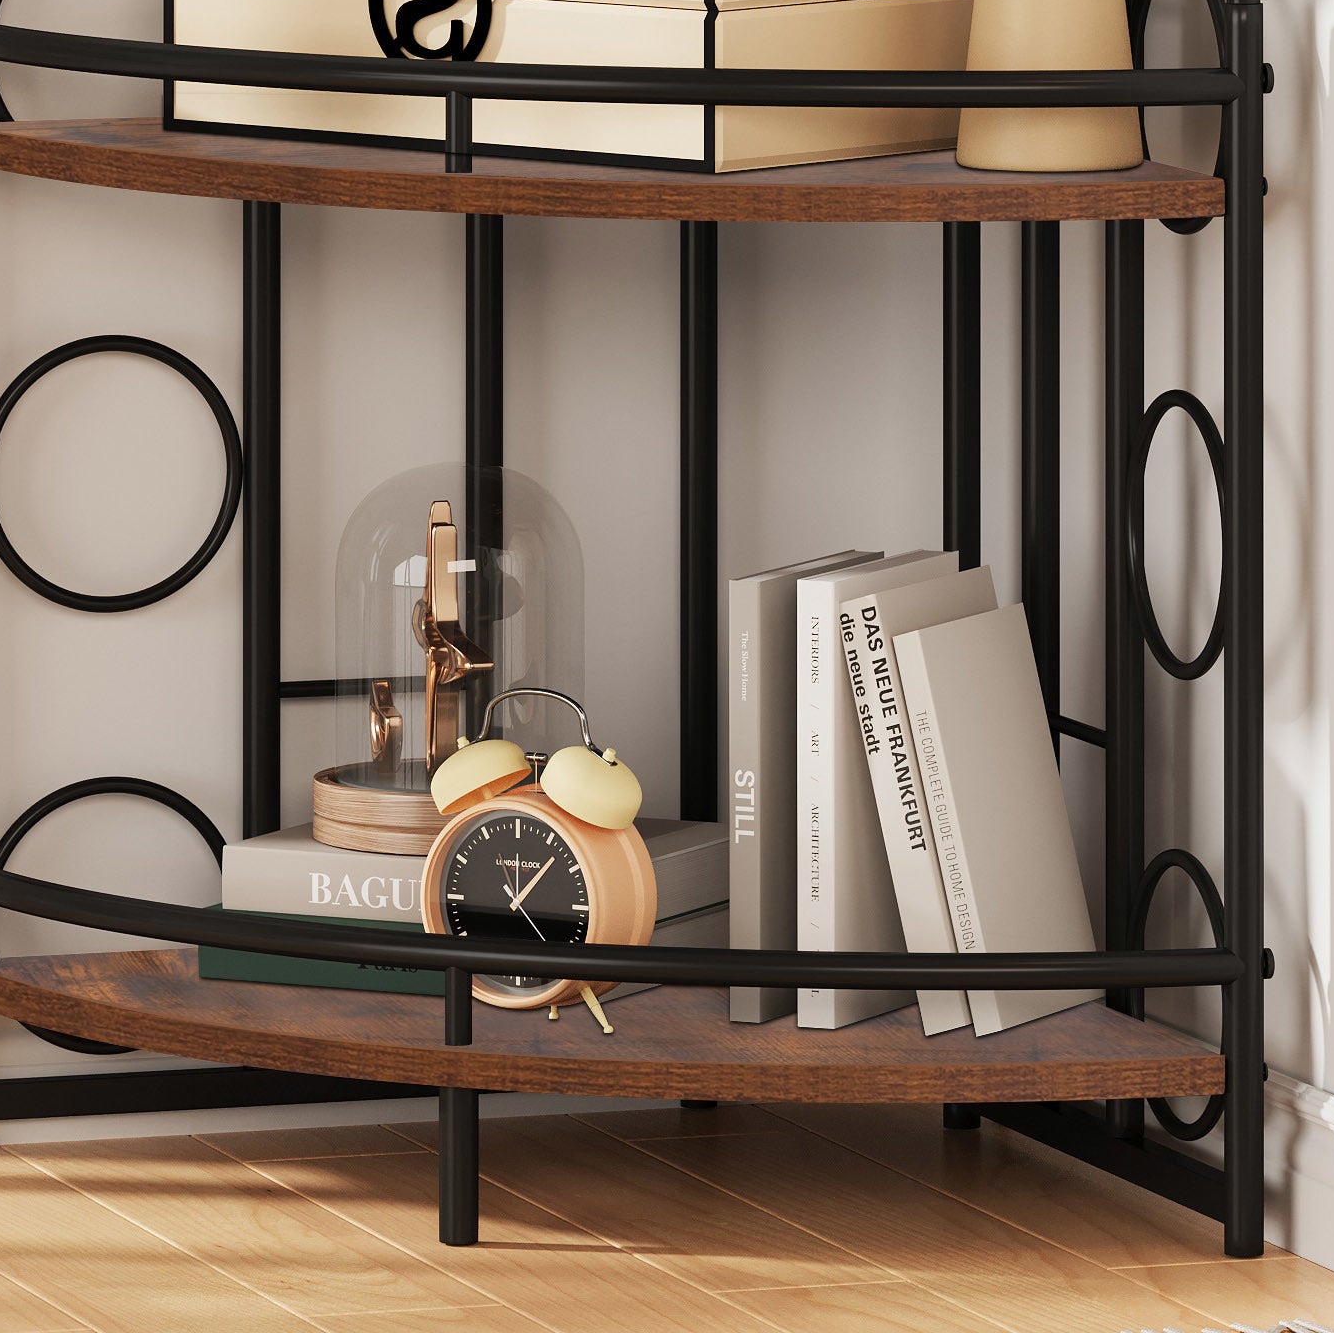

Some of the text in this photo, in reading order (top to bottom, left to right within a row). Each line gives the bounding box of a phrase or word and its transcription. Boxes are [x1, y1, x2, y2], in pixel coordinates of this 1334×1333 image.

[741, 630, 749, 702] The Slow Home
[811, 616, 820, 684] INTERIORS
[839, 612, 880, 756] die neue stadt
[811, 730, 820, 757] ART
[861, 605, 927, 852] DAS NEUE FRANKFURT
[734, 769, 755, 844] STILL
[915, 710, 976, 951] THE COMPLETE GUIDE TO HOME DESIGN
[521, 860, 541, 870] CLOCK
[811, 802, 820, 903] ARCHITECTURE
